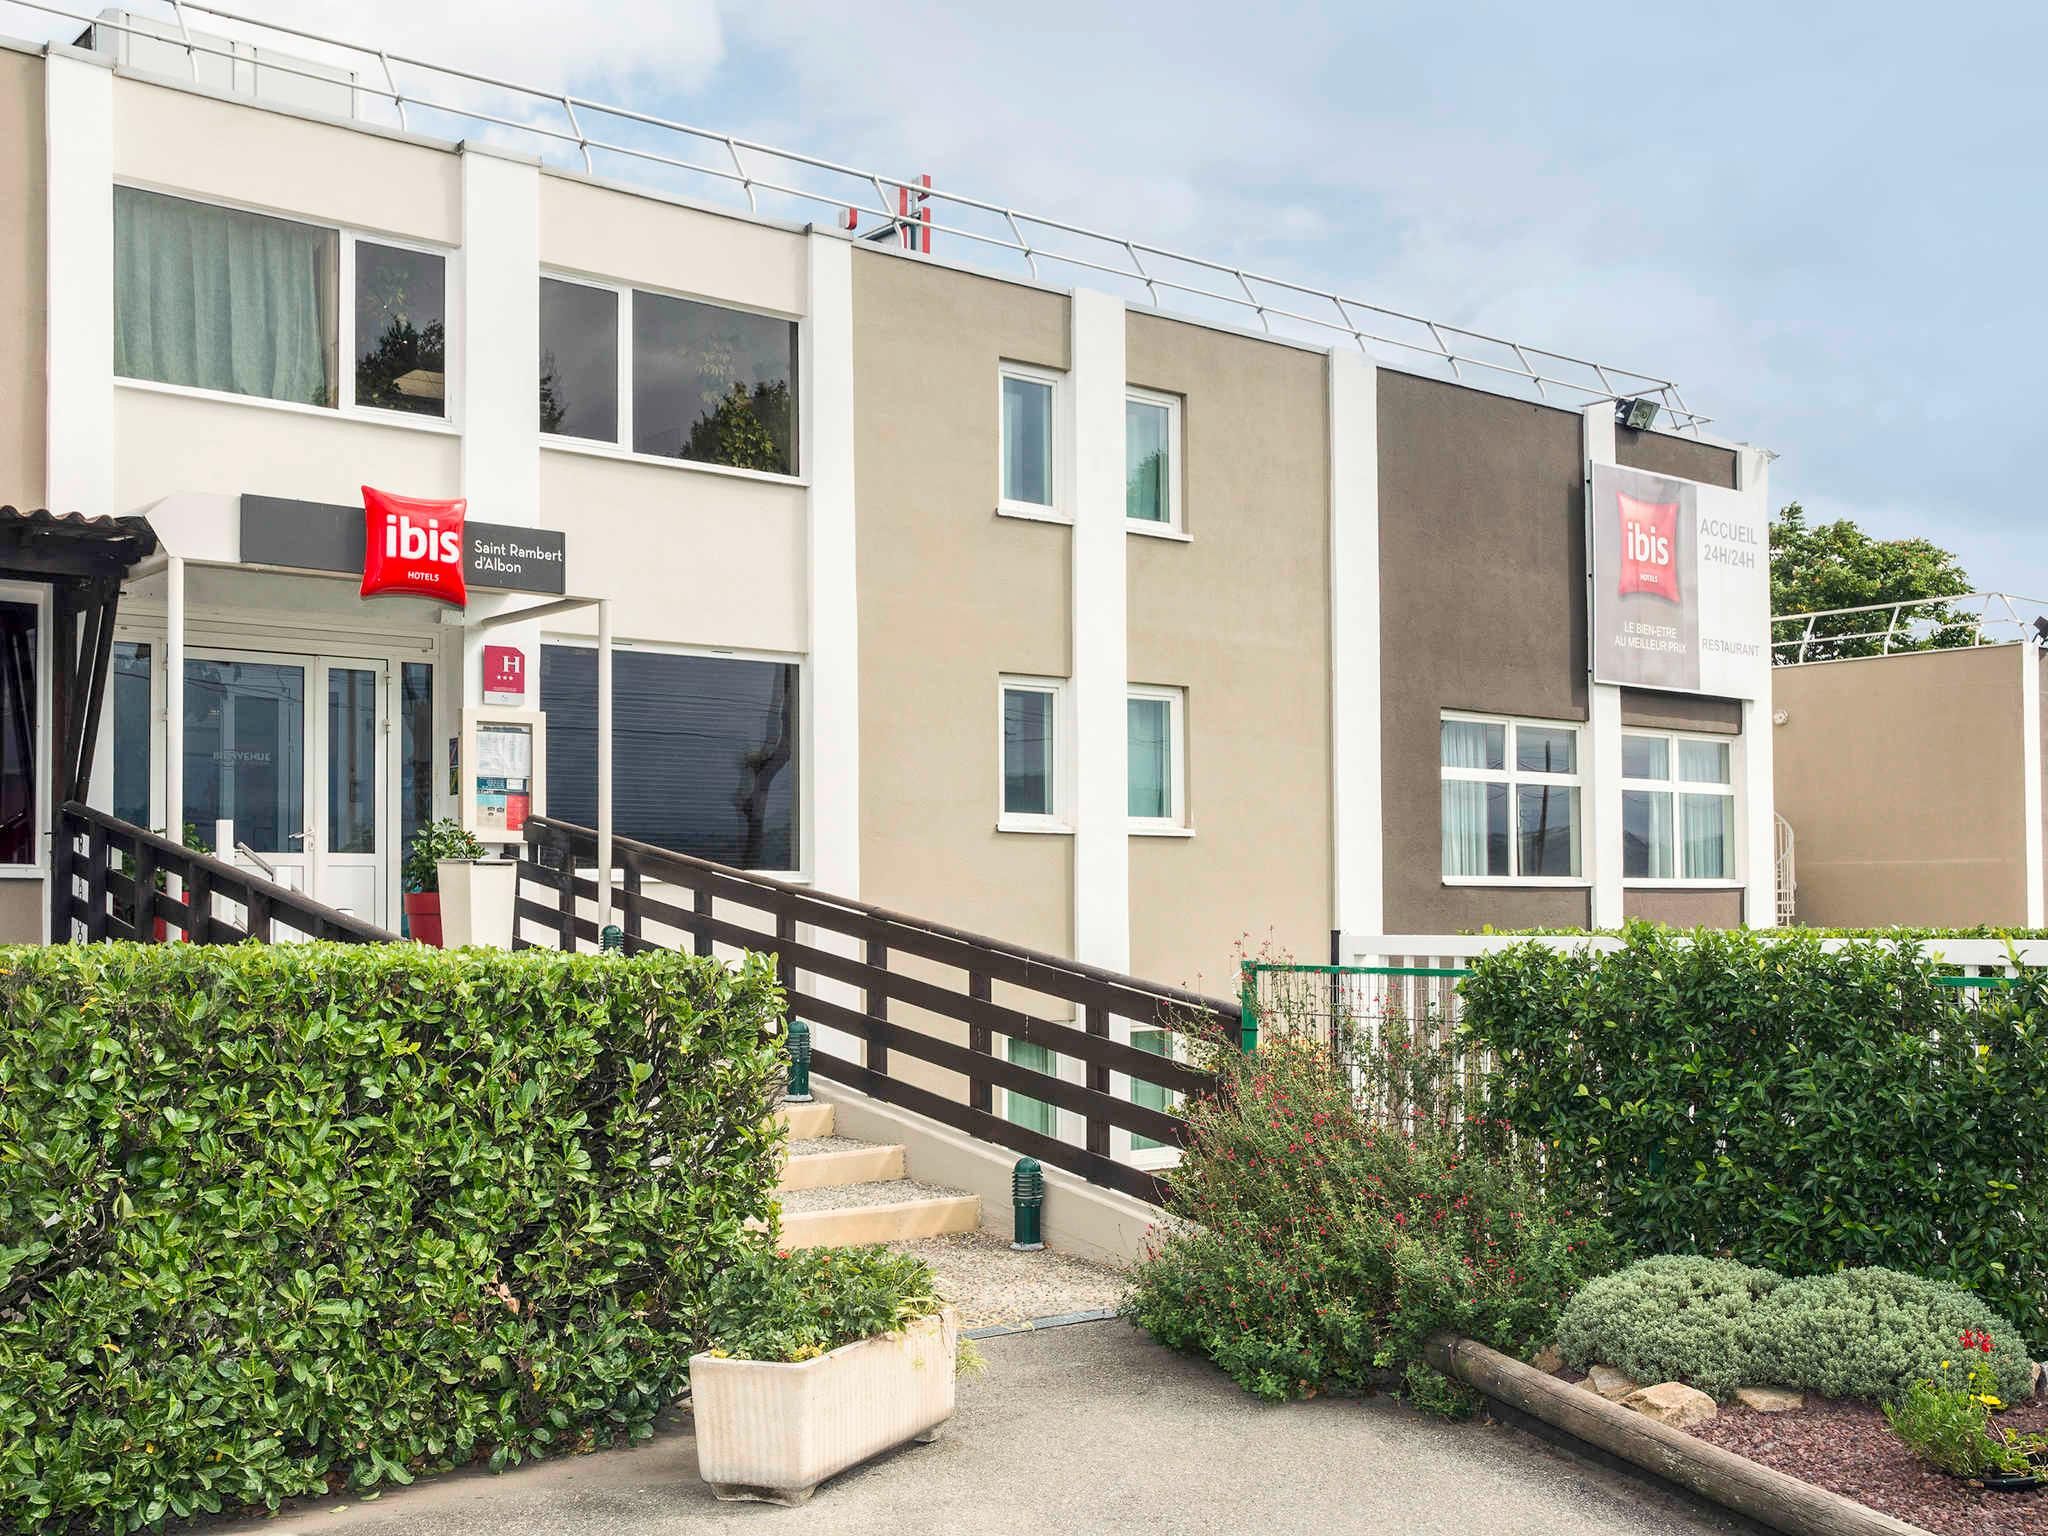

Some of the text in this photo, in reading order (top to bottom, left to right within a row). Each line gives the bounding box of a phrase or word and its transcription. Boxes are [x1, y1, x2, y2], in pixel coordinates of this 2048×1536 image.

[386, 514, 460, 563] ibis
[1701, 519, 1758, 545] ACCUEIL
[474, 540, 563, 562] Saint Rambert
[1627, 520, 1669, 566] ibis
[474, 557, 522, 573] d'Albon
[1704, 544, 1755, 569] 24H/24H
[407, 570, 440, 583] HOTELS
[1624, 621, 1635, 633] LE
[1614, 634, 1688, 654] AU MEILLEUR PRIX
[1703, 638, 1760, 657] RESTAURANT
[503, 655, 521, 674] H
